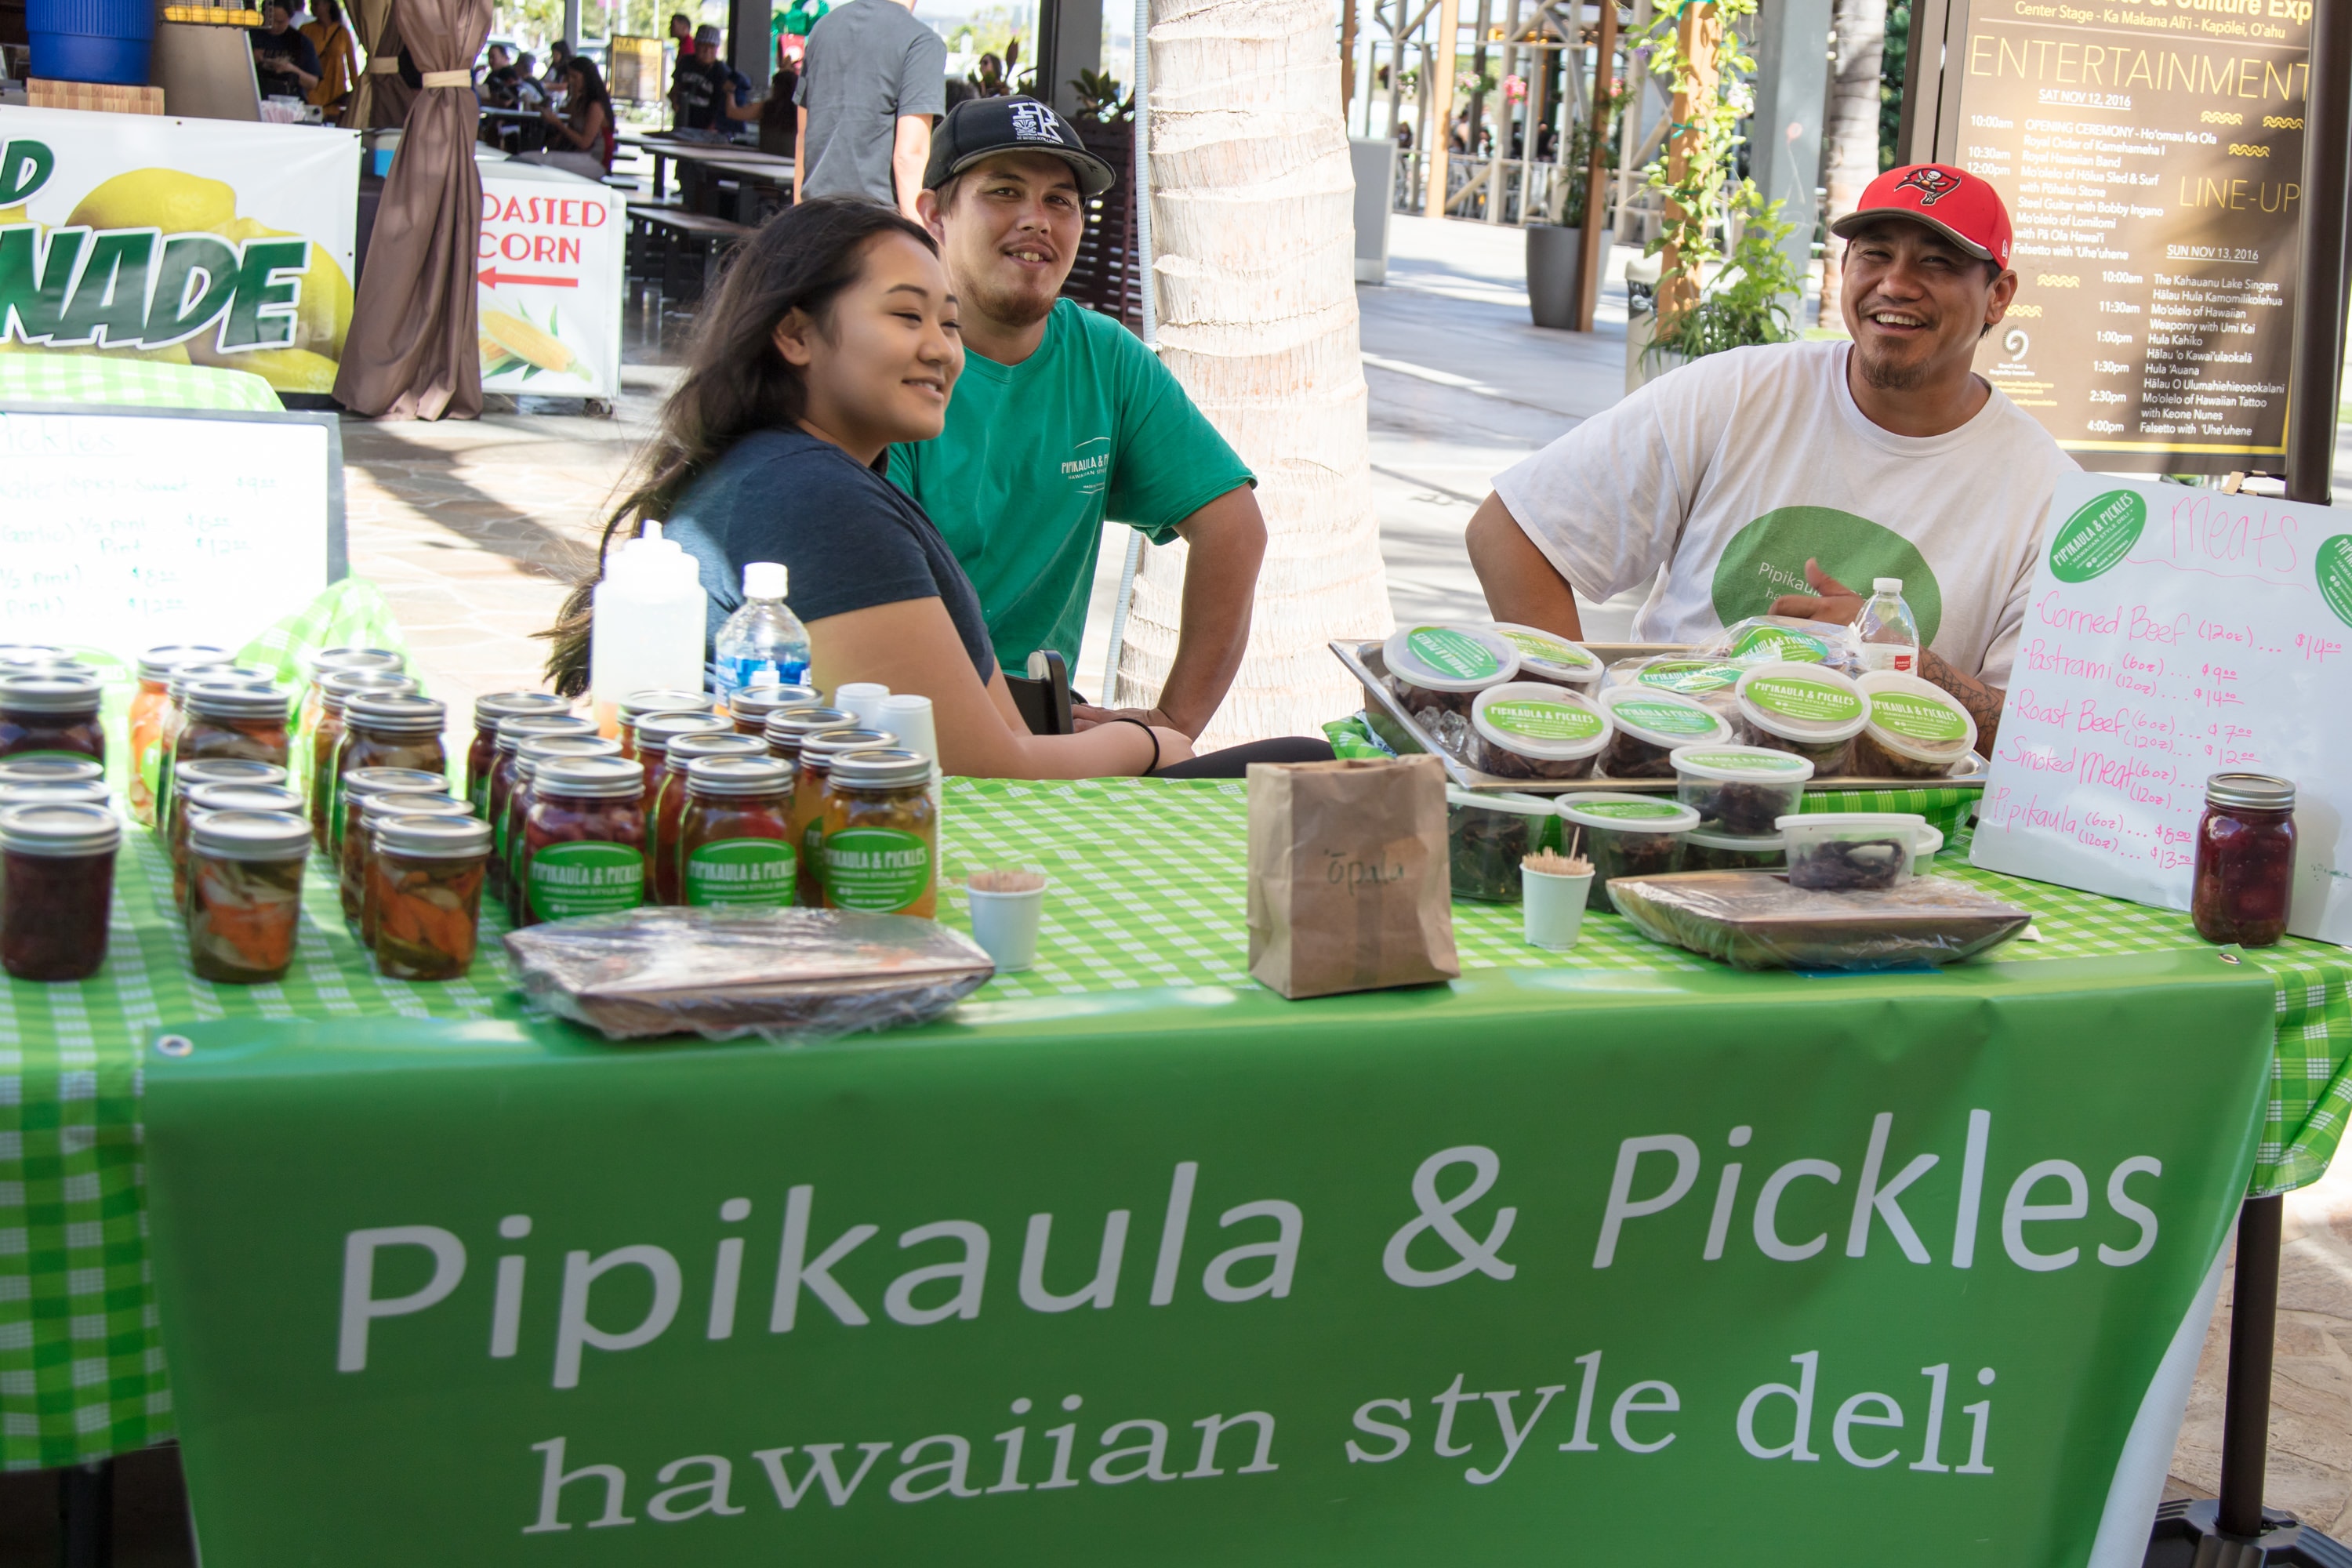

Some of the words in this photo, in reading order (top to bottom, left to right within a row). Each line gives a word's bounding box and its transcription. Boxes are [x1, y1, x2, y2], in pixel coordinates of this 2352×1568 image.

[2015, 1, 2056, 17] Center
[2059, 5, 2093, 24] Stage
[2103, 9, 2118, 24] Ka
[2122, 11, 2167, 27] Makana
[1971, 35, 2310, 101] ENTERTAINMENT
[2039, 89, 2060, 101] SAT
[2062, 91, 2085, 103] NOV
[2089, 93, 2103, 106] 12,
[2105, 94, 2131, 107] 2016
[1971, 115, 2013, 129] 10:00am
[2025, 119, 2074, 133] OPENING
[2076, 122, 2134, 138] CEREMONY
[2185, 131, 2198, 143] Ke
[2200, 132, 2217, 144] Ola
[2024, 135, 2050, 149] Royal
[2053, 136, 2081, 149] Order
[2083, 139, 2094, 150] of
[2095, 140, 2159, 155] Kamehameha
[1969, 147, 2011, 160] 10:30am
[2023, 151, 2049, 165] Royal
[2051, 152, 2093, 165] Hawaiian
[2096, 155, 2121, 168] Band
[1966, 162, 2010, 177] 12:00pm
[2064, 169, 2075, 180] of
[2107, 172, 2128, 183] Sled
[2140, 173, 2159, 186] Surf
[2020, 183, 2039, 193] with
[2078, 185, 2106, 198] Stone
[2180, 176, 2300, 213] LINE-UP
[2018, 197, 2042, 209] Steel
[2045, 198, 2073, 210] Guitar
[2075, 201, 2096, 212] with
[2097, 201, 2129, 217] Bobby
[2130, 205, 2163, 219] Ingano
[2060, 214, 2071, 226] of
[2072, 216, 2116, 229] Lomilomi
[2014, 228, 2034, 239] with
[2051, 230, 2068, 241] Ola
[478, 231, 580, 264] CORN
[2013, 243, 2051, 256] Falsetto
[2053, 245, 2073, 256] with
[2167, 245, 2188, 256] SUN
[2191, 246, 2215, 258] NOV
[2218, 248, 2232, 260] 13,
[2234, 249, 2259, 260] 2016
[2102, 271, 2143, 284] 10:00am
[2154, 274, 2172, 285] The
[2173, 275, 2219, 288] Kahauanu
[2222, 278, 2243, 289] Lake
[2245, 279, 2278, 293] Singers
[2182, 291, 2202, 302] Hula
[2100, 301, 2140, 314] 11:30am
[2194, 306, 2204, 316] of
[2205, 307, 2246, 319] Hawaiian
[2150, 319, 2197, 334] Weaponry
[2200, 321, 2218, 332] with
[2220, 323, 2239, 333] Umi
[2241, 324, 2256, 334] Kai
[2096, 331, 2132, 345] 1:00pm
[2148, 333, 2169, 345] Hula
[2172, 335, 2202, 346] Kahiko
[2093, 361, 2129, 376] 1:30pm
[2145, 363, 2166, 374] Hula
[2089, 390, 2126, 404] 2:30pm
[2184, 394, 2195, 405] of
[2195, 394, 2237, 406] Hawaiian
[2238, 396, 2267, 408] Tattoo
[2141, 408, 2160, 419] with
[2162, 408, 2191, 419] Keone
[2194, 409, 2223, 420] Nunes
[2087, 420, 2124, 435] 4:00pm
[2140, 422, 2176, 434] Falsetto
[2177, 423, 2196, 434] with
[1062, 456, 1097, 474] PIPIKAULA
[1098, 456, 1103, 466] &
[1069, 470, 1094, 480] HAWAIIAN
[2053, 526, 2096, 566] PIPIKAULA
[2092, 520, 2103, 532] &
[2100, 492, 2133, 525] PICKLES
[2072, 538, 2100, 563] HAWAIIAN
[2100, 524, 2117, 539] STYLE
[2116, 513, 2129, 524] DELI
[2172, 496, 2298, 572] Meats
[2042, 590, 2122, 634] Corned
[2129, 605, 2190, 646] Beef
[2029, 639, 2113, 679] Pastrami
[1755, 682, 1804, 697] PIPIKAULA
[1807, 691, 1814, 699] &
[1817, 691, 1854, 706] PICKLES
[1545, 711, 1552, 720] &
[1555, 712, 1594, 724] PICKLES
[1873, 700, 1913, 714] IPIKAULA
[1915, 706, 1922, 716] &
[1923, 707, 1957, 721] PICKLES
[2017, 689, 2073, 728] Roast
[2078, 699, 2129, 737] Beef
[2001, 736, 2076, 772] Smoked
[2079, 752, 2135, 791] Meat
[1994, 787, 2076, 833] Pipikaula
[336, 1161, 1304, 1388] Pipikaula
[1381, 1145, 1518, 1287] &
[1592, 1109, 2163, 1272] Pickles
[522, 1394, 1279, 1533] hawaiian
[1344, 1349, 1680, 1486] style
[1736, 1349, 1996, 1475] deli
